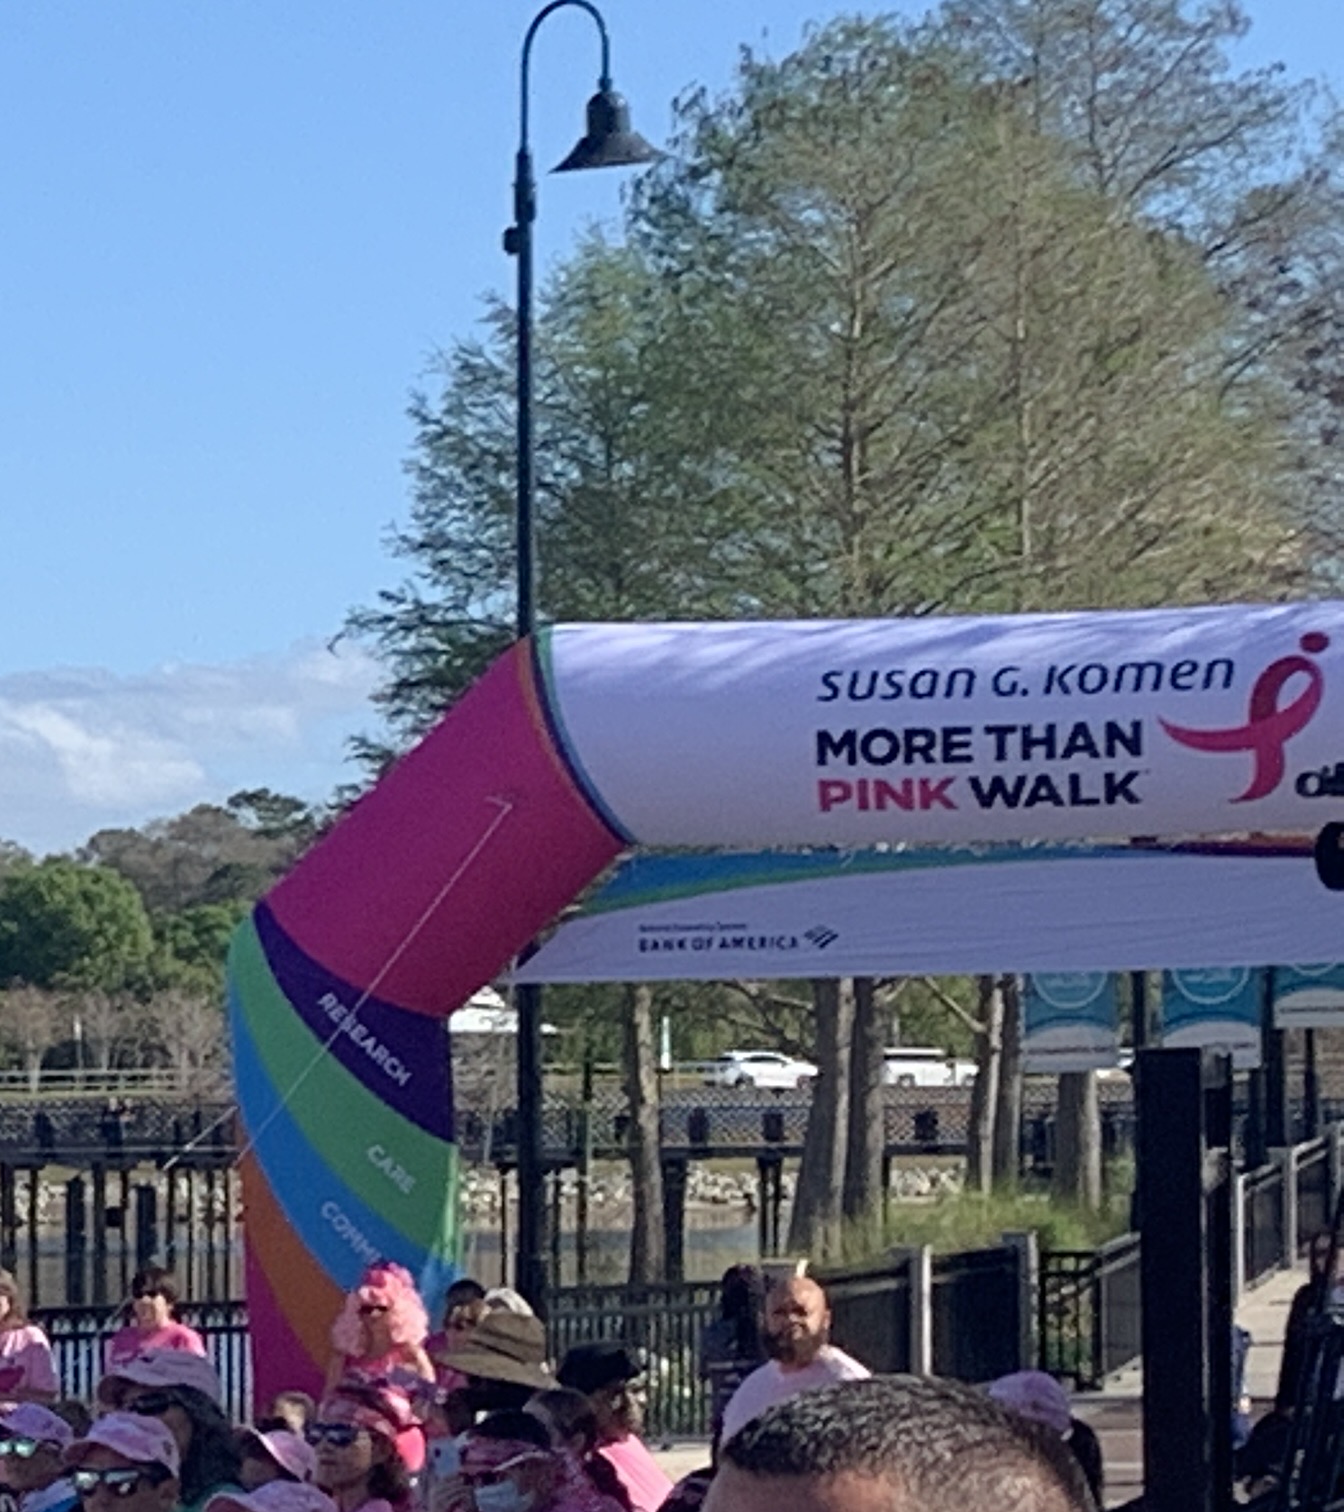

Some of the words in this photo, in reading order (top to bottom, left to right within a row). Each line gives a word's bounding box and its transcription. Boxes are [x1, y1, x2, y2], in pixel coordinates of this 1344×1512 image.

[816, 726, 974, 766] MORE
[984, 720, 1143, 761] THAN
[818, 776, 959, 812] PINK
[969, 769, 1144, 809] WALK
[719, 936, 798, 950] AMERICA
[317, 992, 413, 1087] RESEARCH
[367, 1144, 416, 1194] CARE
